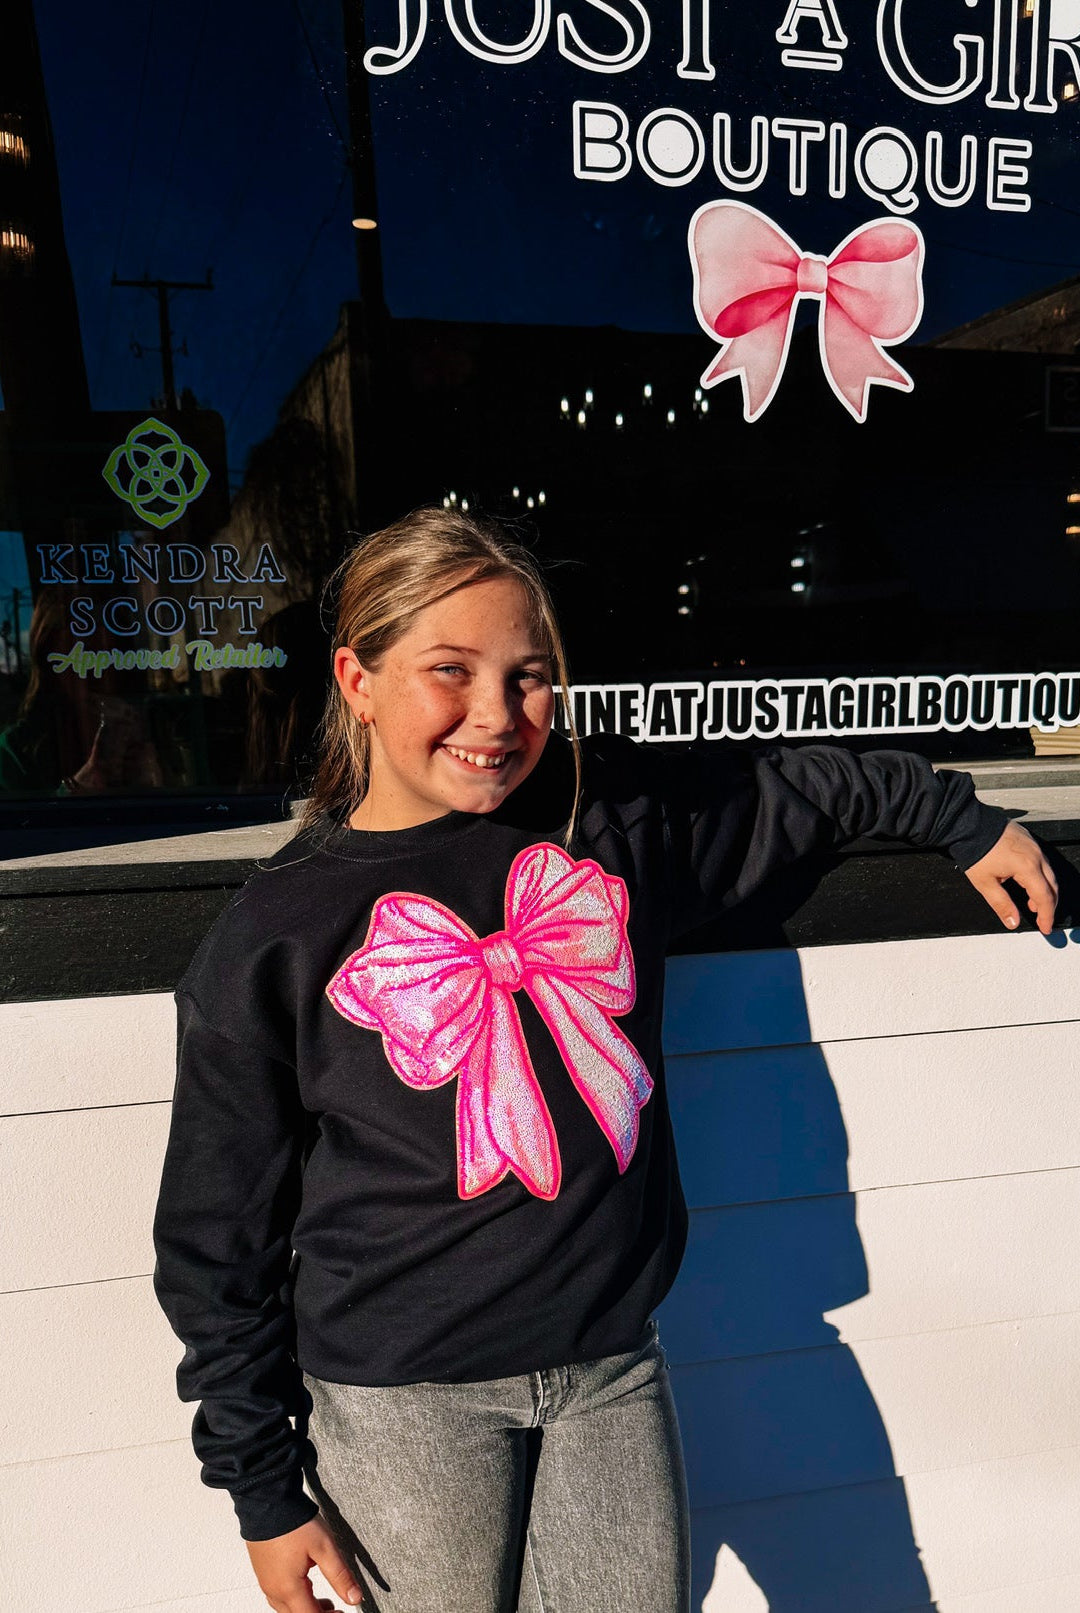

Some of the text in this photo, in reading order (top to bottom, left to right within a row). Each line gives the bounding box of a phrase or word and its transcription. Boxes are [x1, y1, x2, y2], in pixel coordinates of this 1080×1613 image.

[775, 0, 848, 50] A
[572, 100, 1032, 215] BOUTIQUE
[36, 543, 286, 584] KENDRA
[70, 596, 264, 637] SCOTT
[47, 639, 288, 678] Approved Retailer
[648, 684, 702, 740] AT
[704, 674, 1080, 738] JUSTAGIRLBOUTIQU
